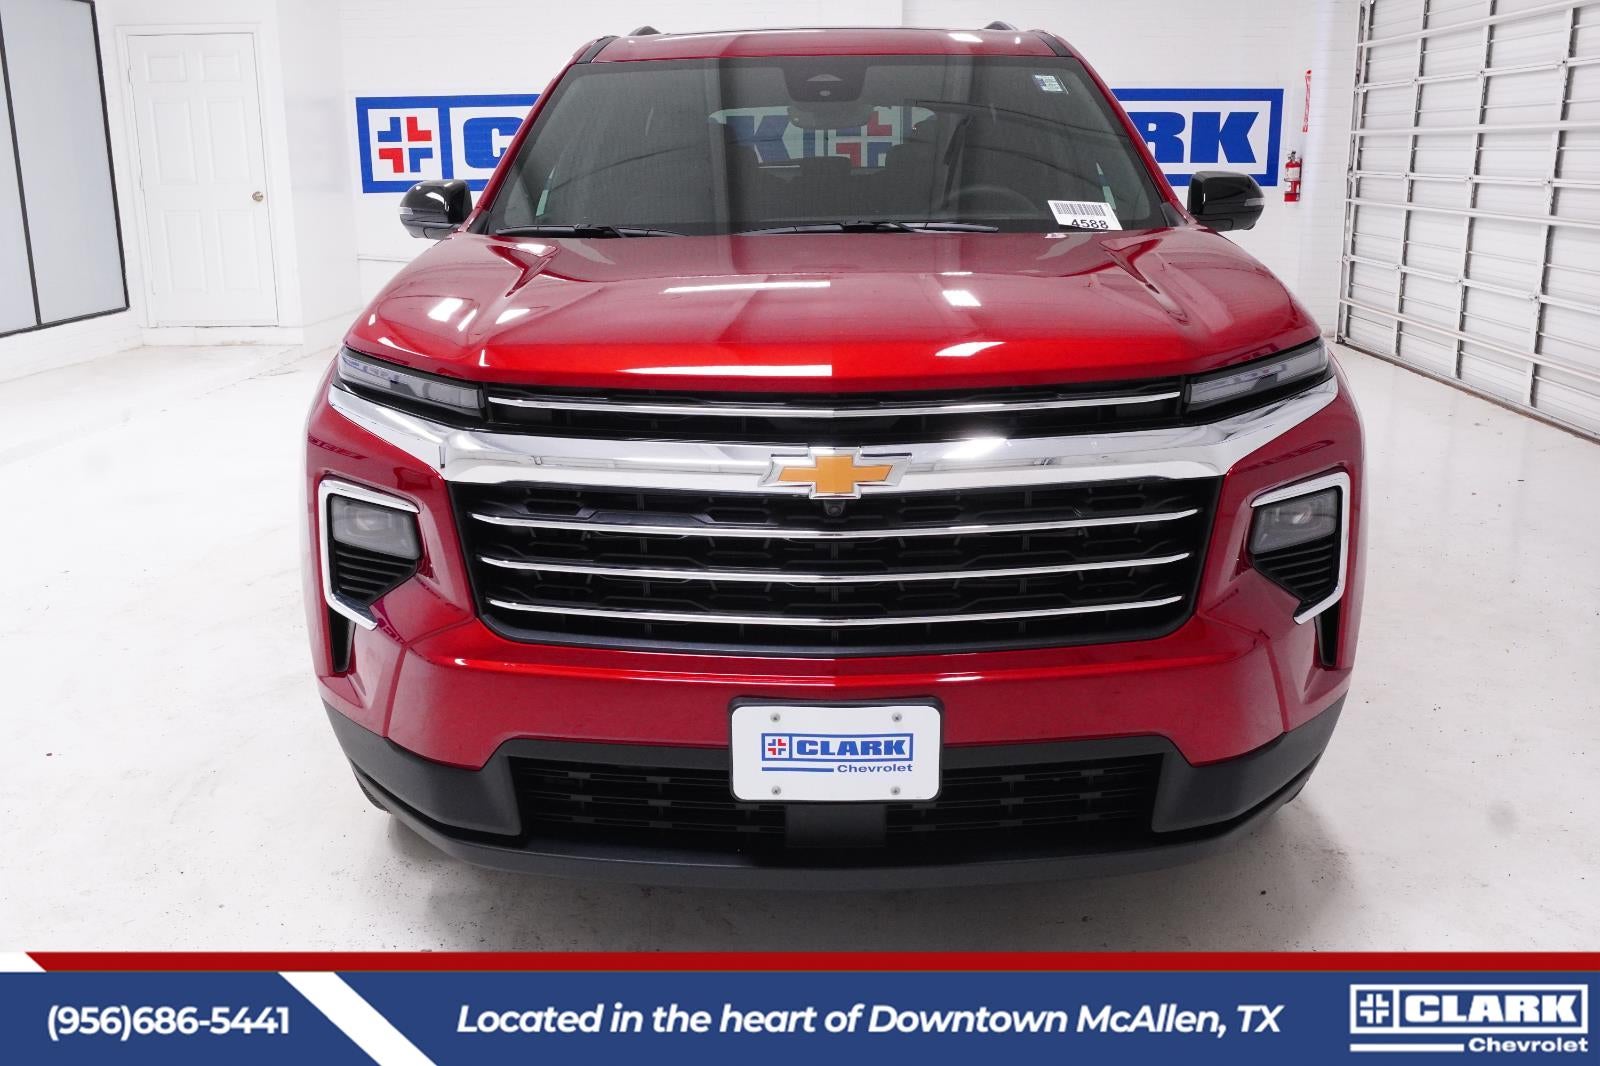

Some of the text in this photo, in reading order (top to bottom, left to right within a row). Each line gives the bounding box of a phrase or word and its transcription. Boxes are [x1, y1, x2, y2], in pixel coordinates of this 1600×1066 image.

[1071, 219, 1109, 229] 4588
[796, 739, 906, 757] CLARK
[837, 763, 913, 773] Chevrolet
